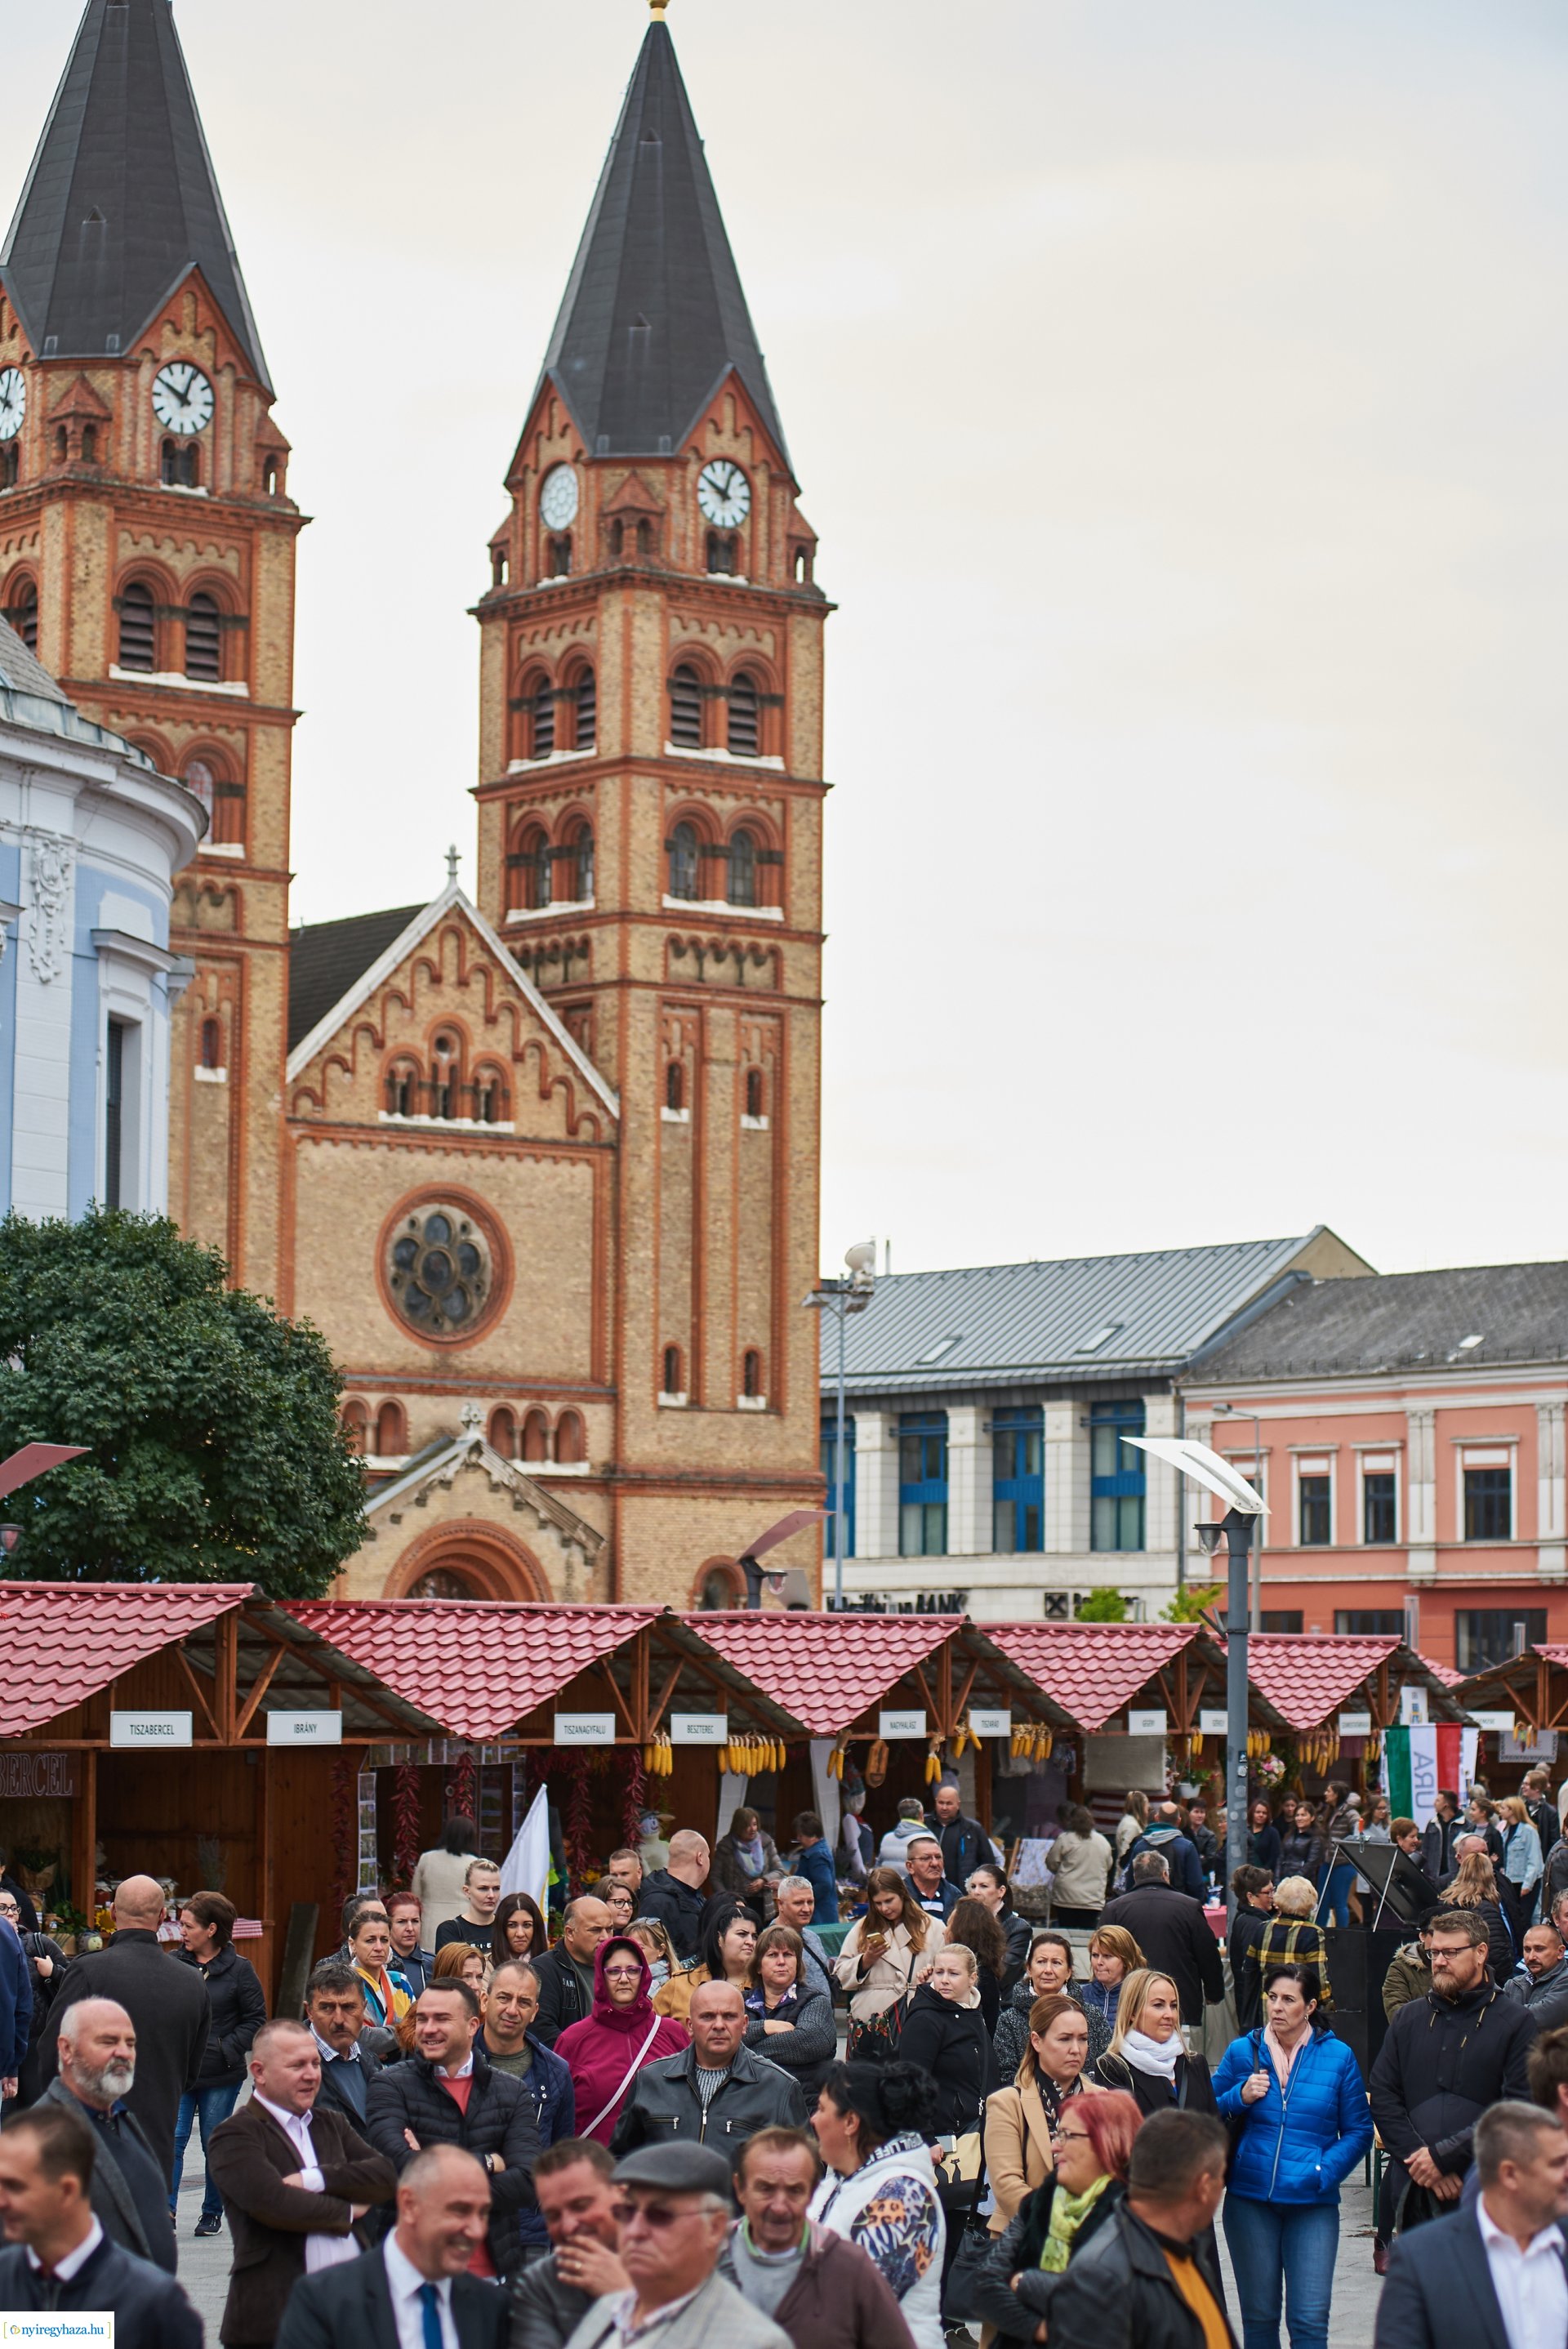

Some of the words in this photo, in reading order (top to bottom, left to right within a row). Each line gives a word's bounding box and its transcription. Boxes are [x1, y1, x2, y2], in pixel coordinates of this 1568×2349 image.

[130, 1724, 175, 1736] TISZABERCEL
[293, 1722, 317, 1734] IBRÁNY
[564, 1725, 606, 1735] TISZANAGYFALU
[687, 1724, 714, 1734] BESZTEREC
[889, 1720, 916, 1730] NAGYHALÁSZ
